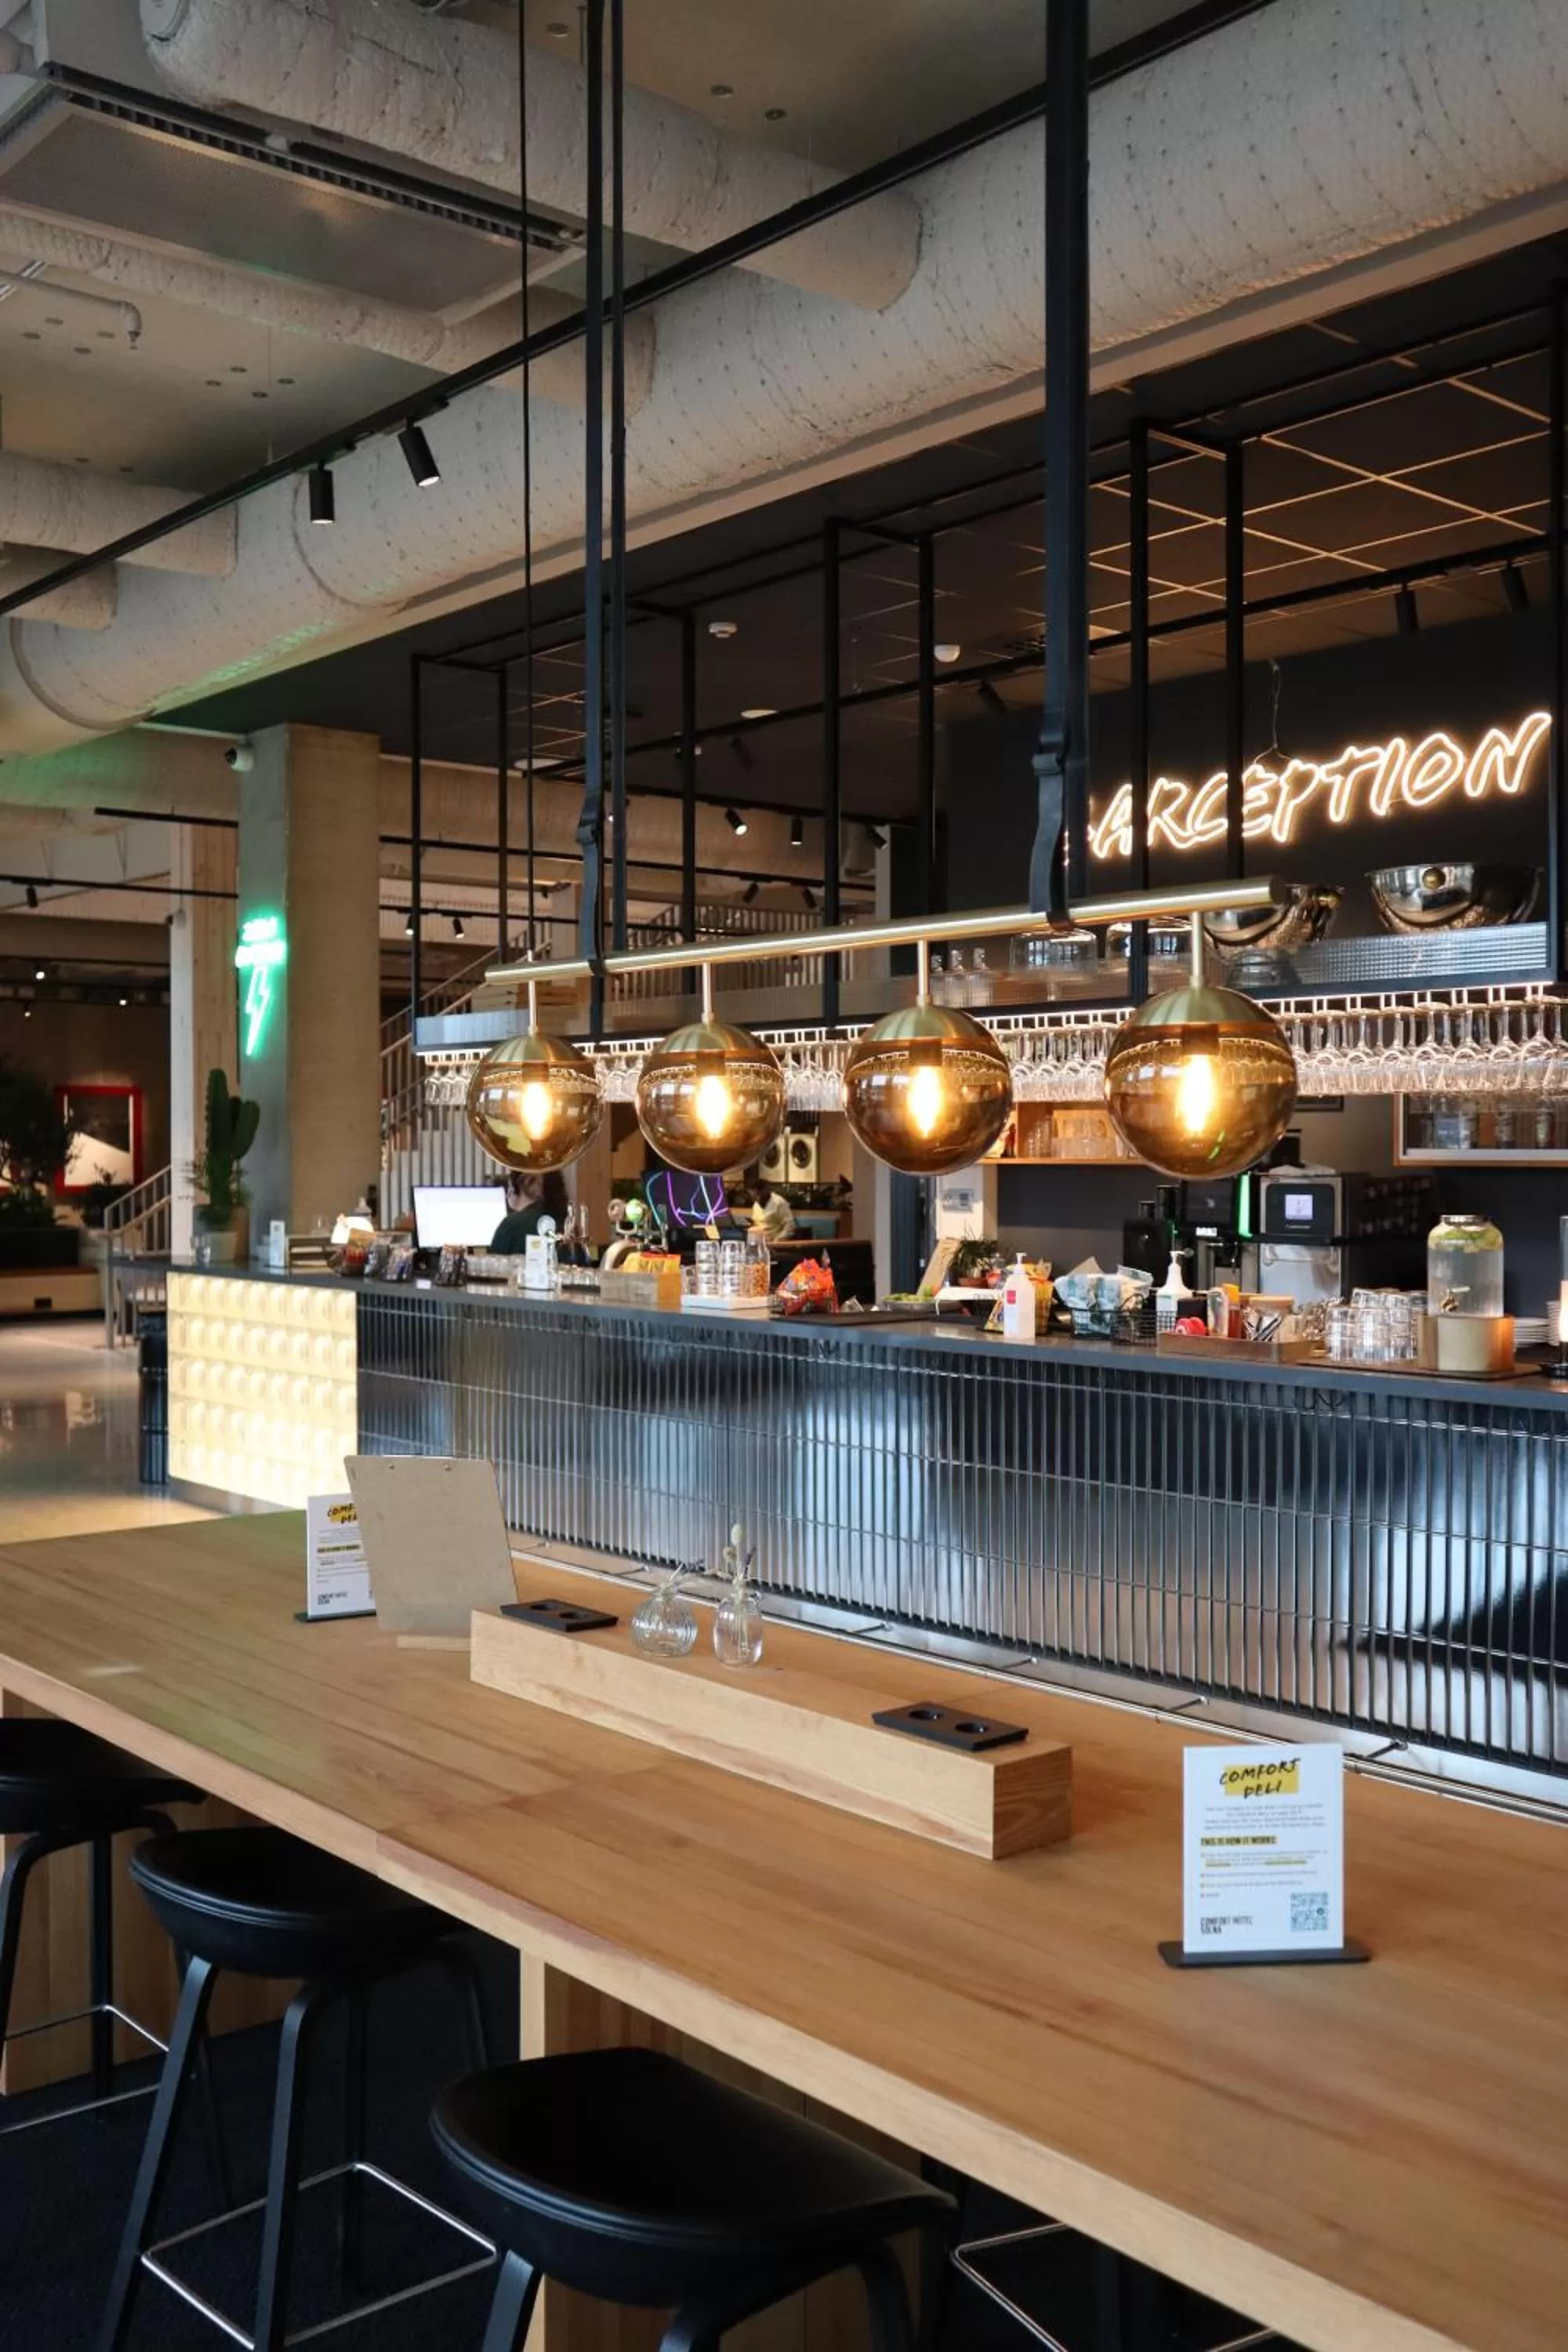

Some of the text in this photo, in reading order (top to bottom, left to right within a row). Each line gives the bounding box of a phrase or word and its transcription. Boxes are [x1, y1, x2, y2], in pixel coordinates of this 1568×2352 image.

[1064, 711, 1553, 866] ARCEPTION
[1219, 1757, 1301, 1785] COMFORT
[1243, 1779, 1283, 1799] DELI
